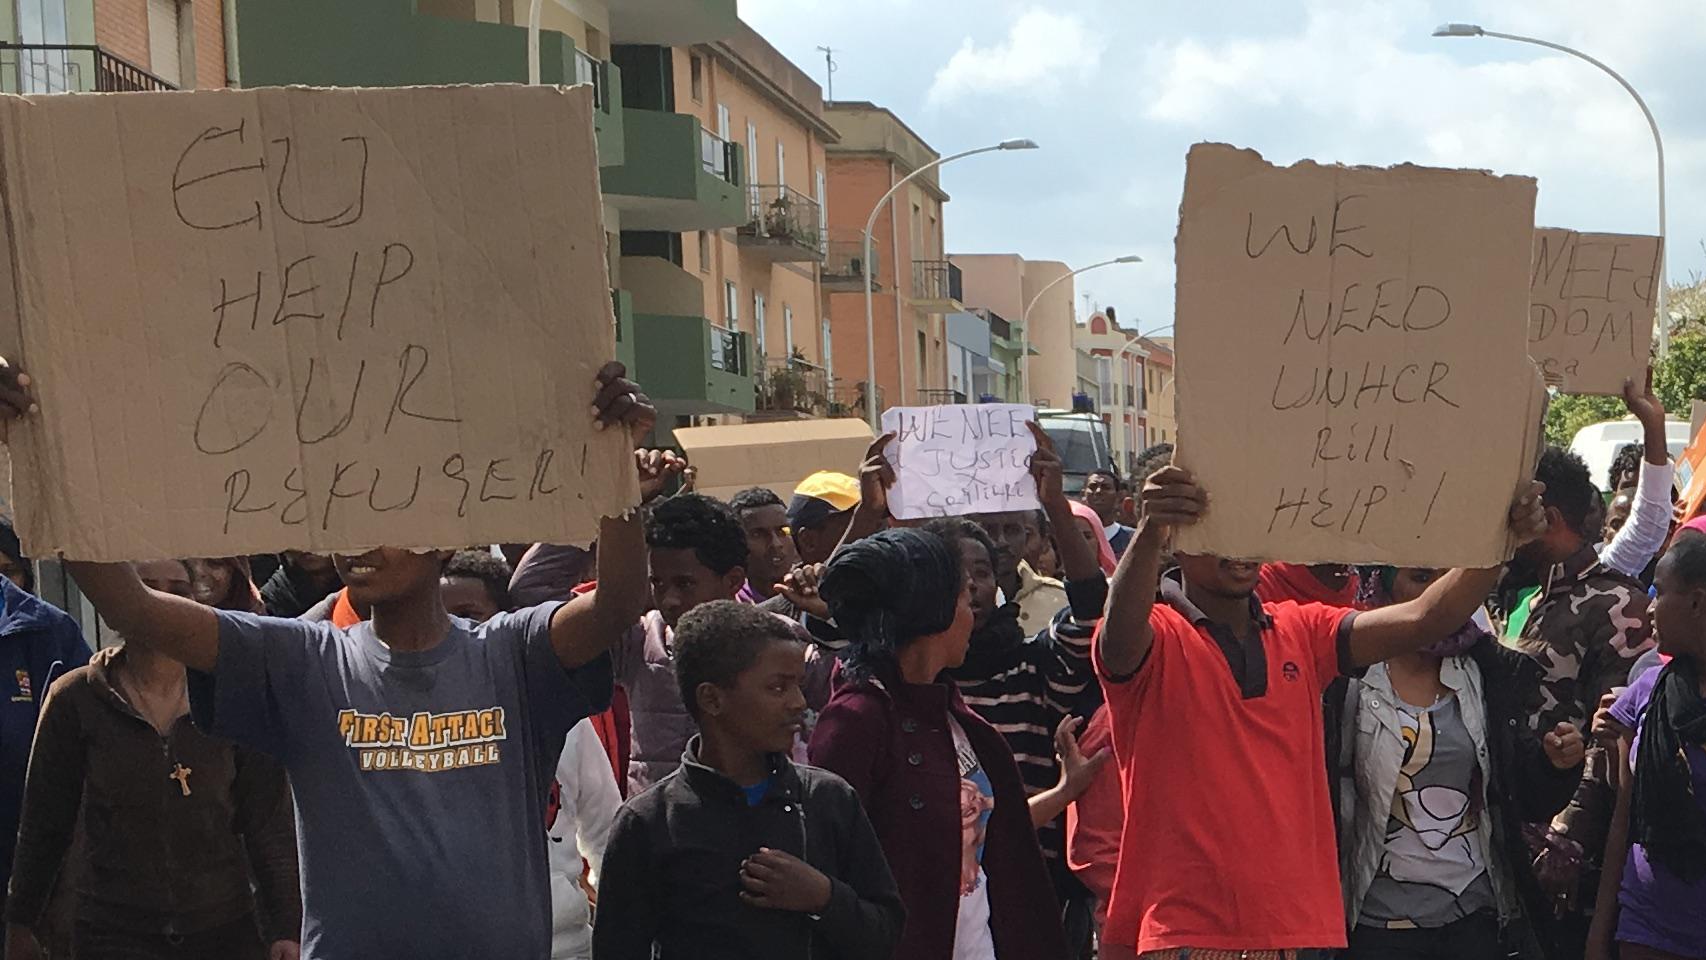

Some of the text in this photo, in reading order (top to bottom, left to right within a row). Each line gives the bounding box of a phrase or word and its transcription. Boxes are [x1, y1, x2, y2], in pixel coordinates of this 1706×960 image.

[172, 119, 368, 229] EU
[1245, 194, 1374, 258] WE
[1284, 278, 1450, 344] NEED
[193, 344, 462, 454] OUR
[1272, 361, 1459, 410] UNHCR
[898, 405, 1025, 444] WE NEE
[338, 709, 409, 748] FIRST
[361, 744, 500, 772] VOLLEYBALL
